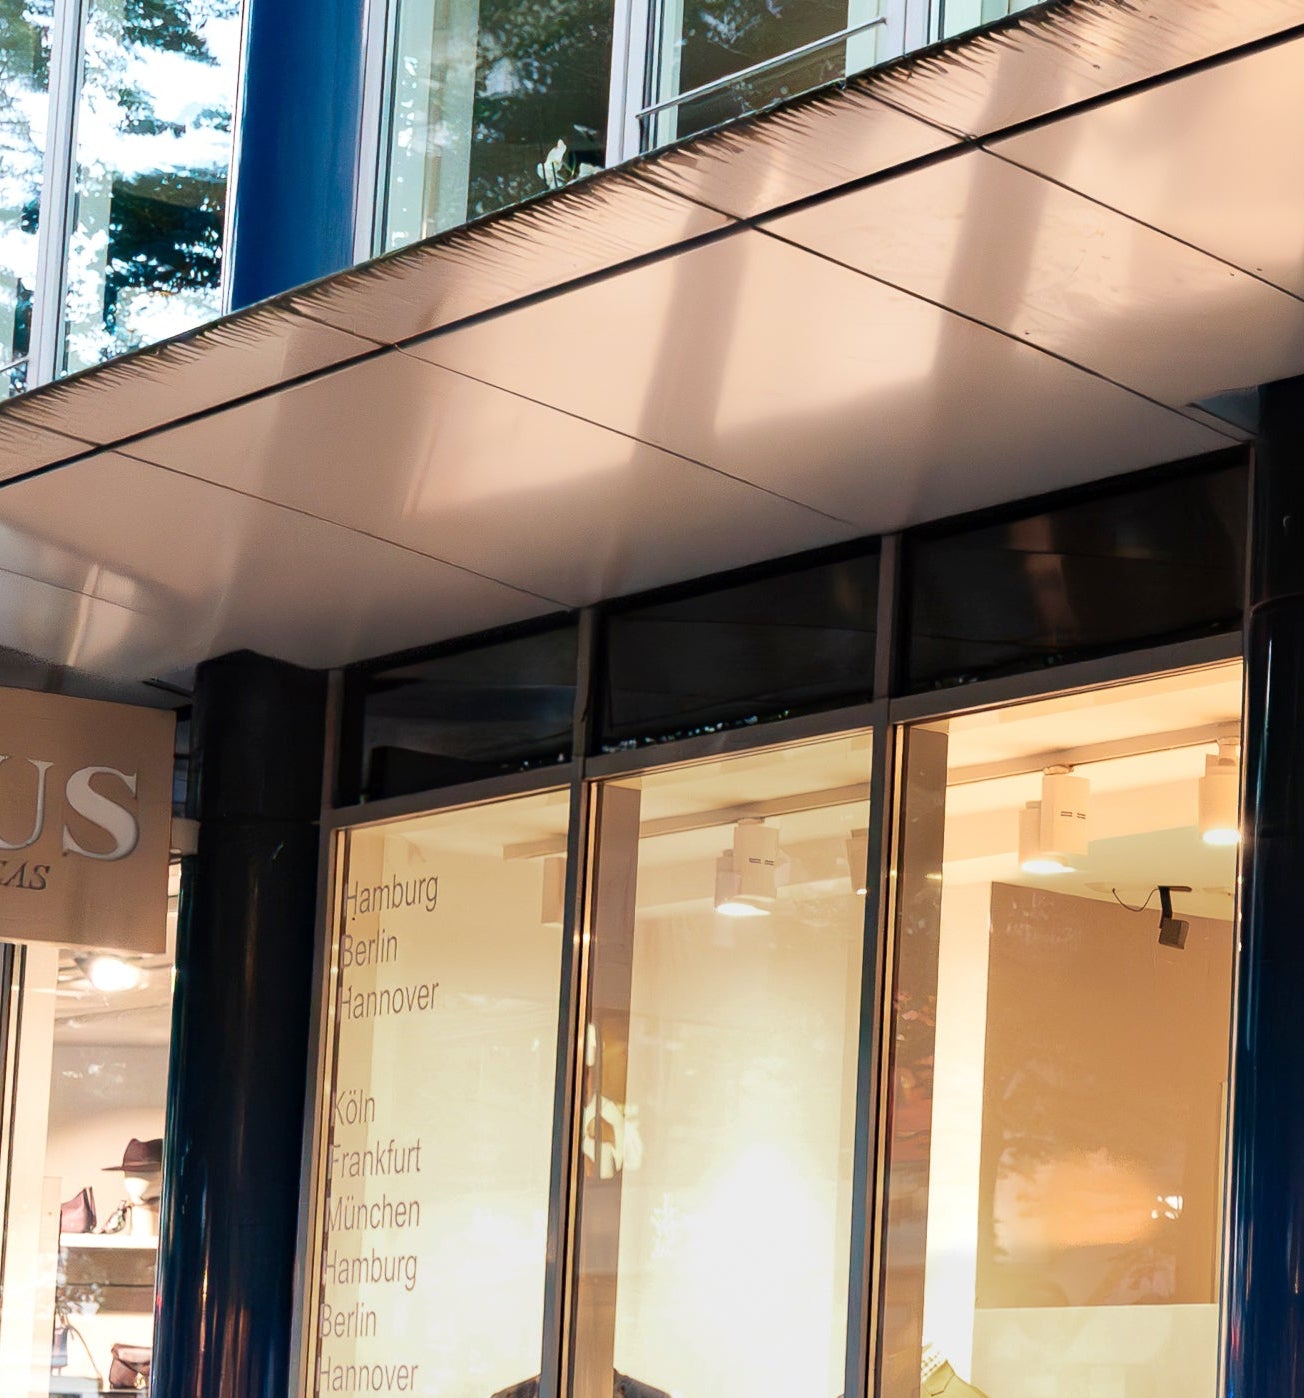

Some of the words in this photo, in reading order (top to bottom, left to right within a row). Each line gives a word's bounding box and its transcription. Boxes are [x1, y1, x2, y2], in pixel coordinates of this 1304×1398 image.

[343, 873, 439, 918] Hamburg
[340, 931, 399, 969] Berlin
[338, 981, 440, 1020] Hannover
[330, 1088, 376, 1126] Köln
[328, 1138, 422, 1179] Frankfurt
[325, 1194, 421, 1232] München
[322, 1248, 418, 1292] Hamburg
[319, 1302, 377, 1339] Berlin
[316, 1356, 419, 1393] Hannover
